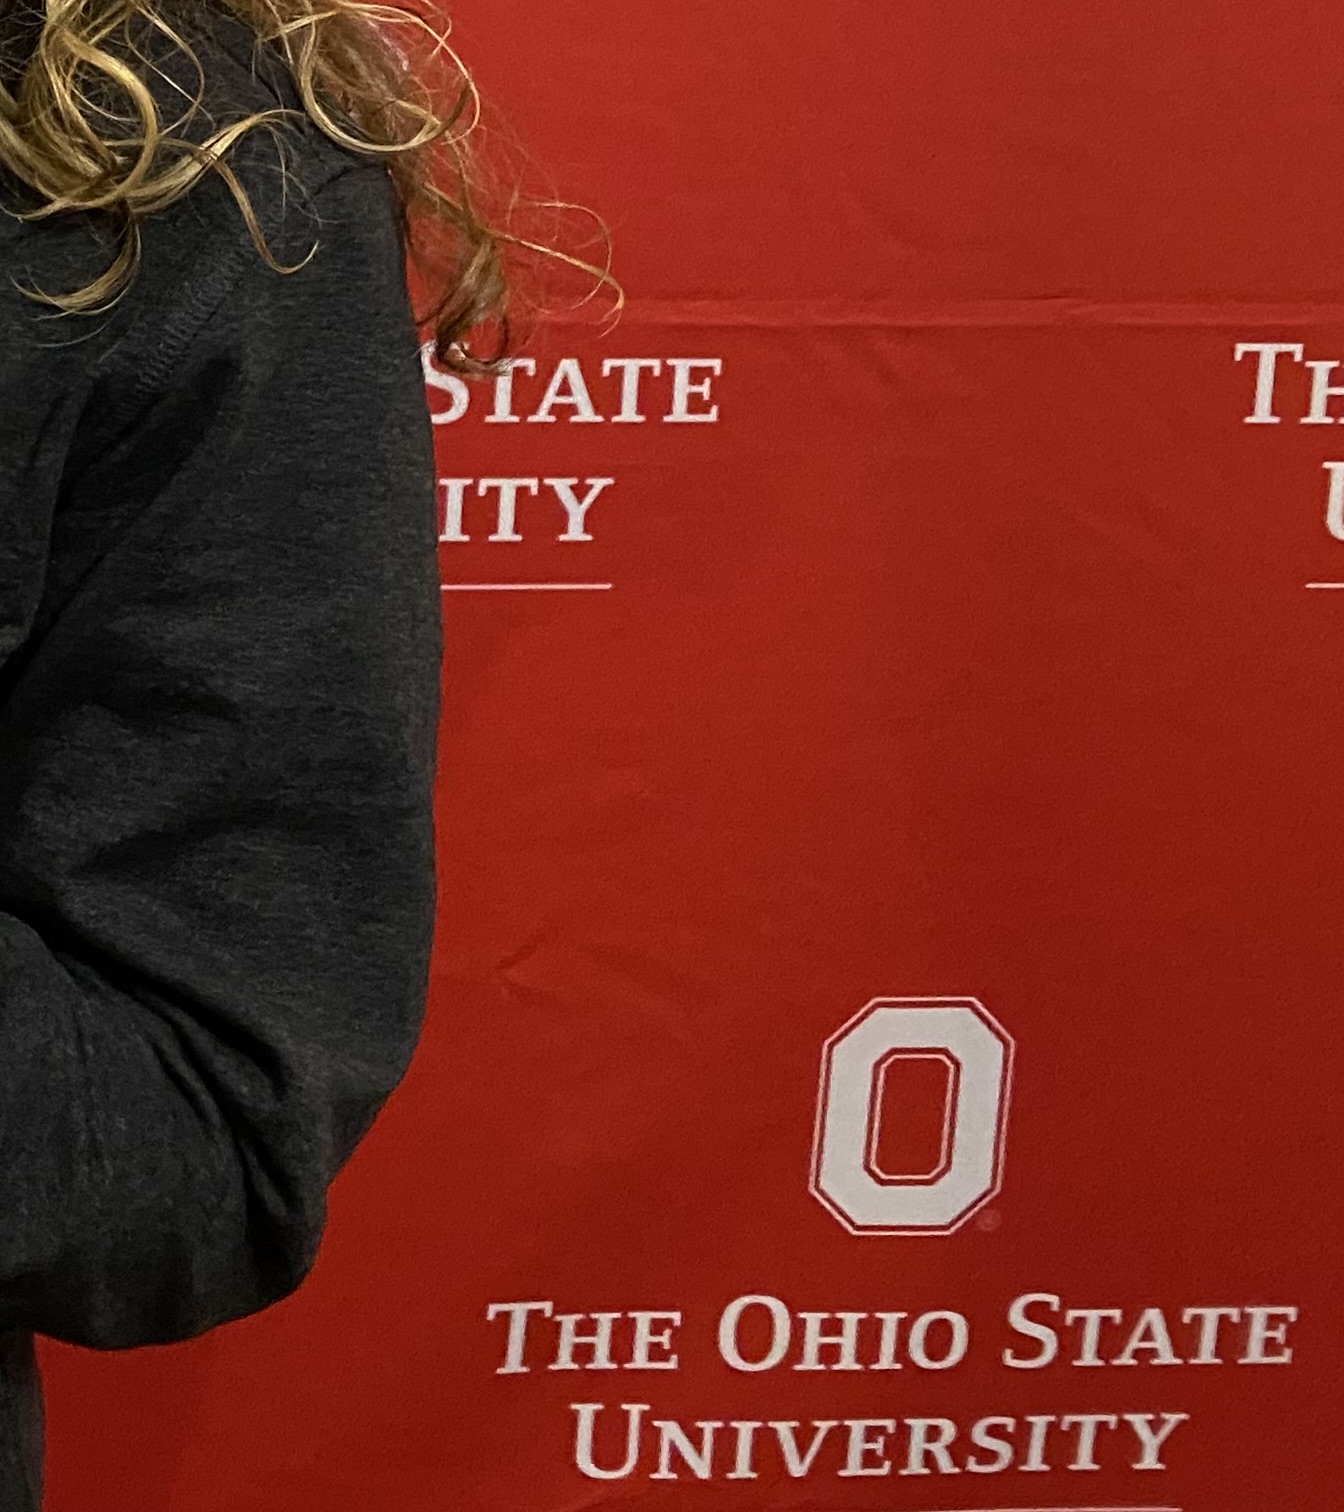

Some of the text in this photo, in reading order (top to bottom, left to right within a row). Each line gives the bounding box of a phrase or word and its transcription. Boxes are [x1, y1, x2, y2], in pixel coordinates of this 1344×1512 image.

[487, 1293, 1297, 1374] THE OHIO STATE
[570, 1403, 1189, 1479] UNIVERSITY
